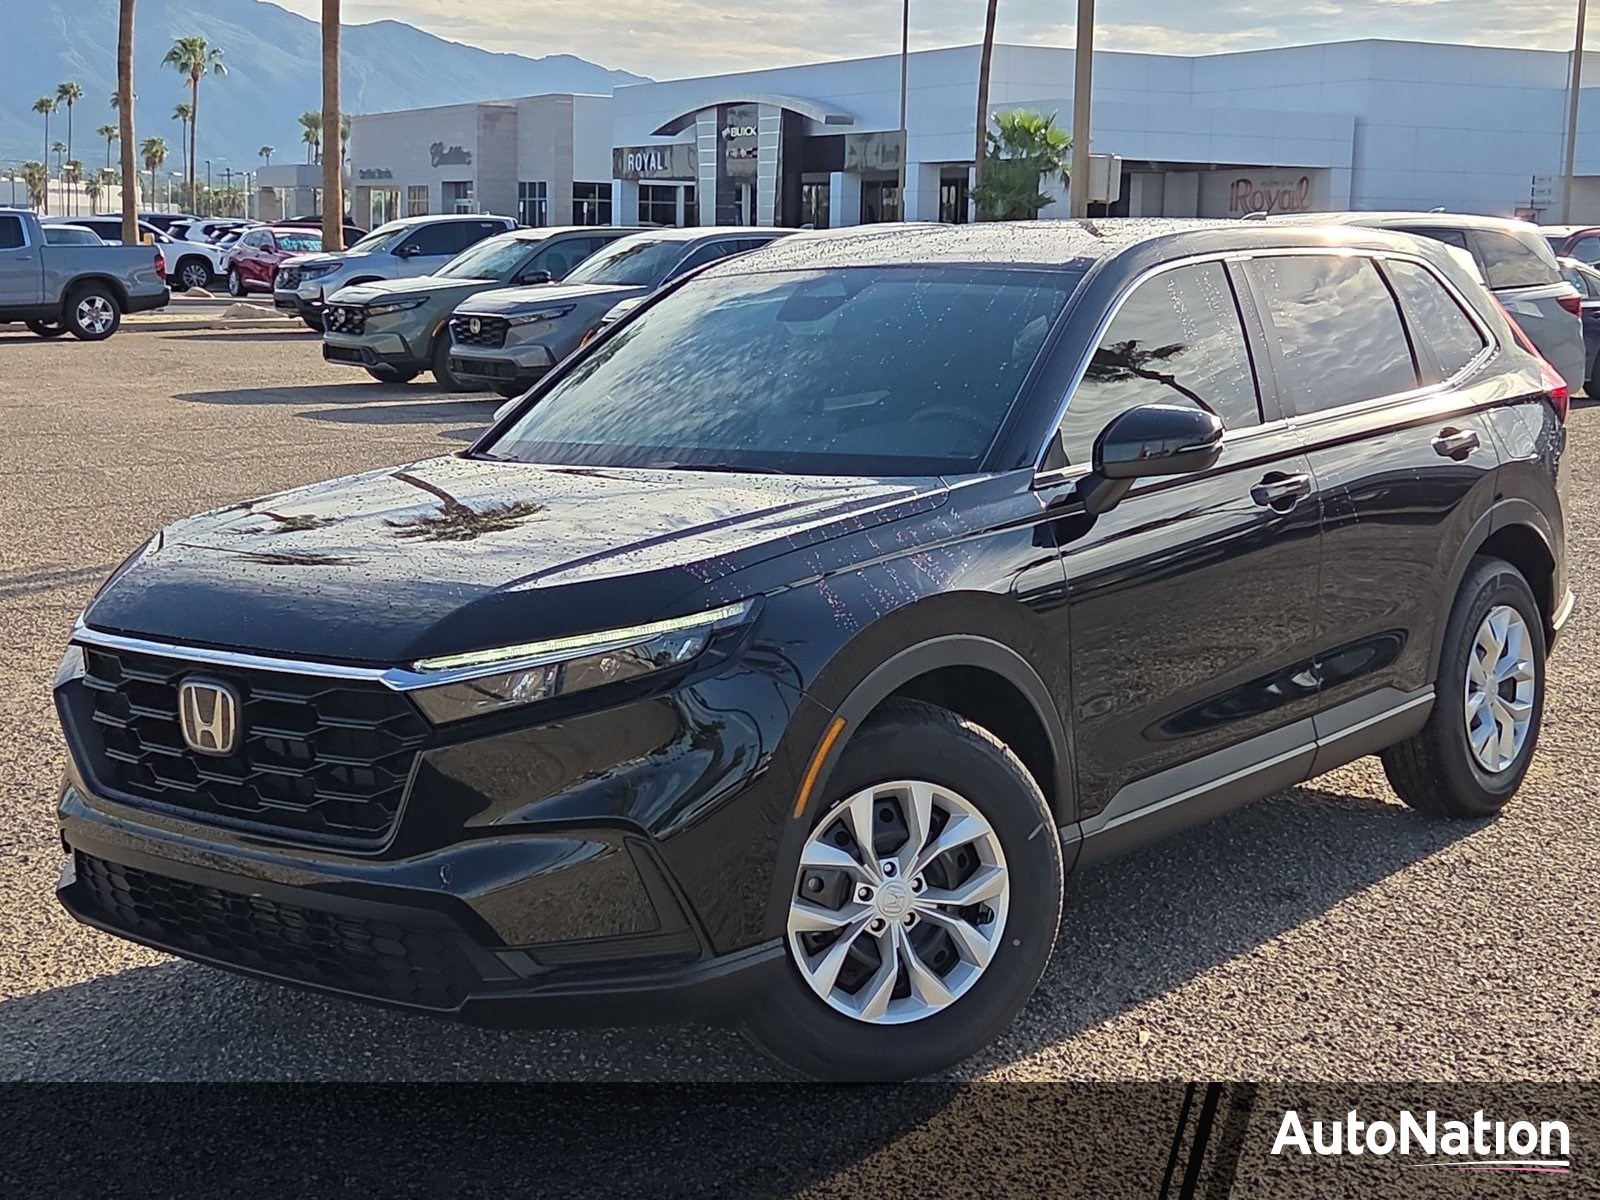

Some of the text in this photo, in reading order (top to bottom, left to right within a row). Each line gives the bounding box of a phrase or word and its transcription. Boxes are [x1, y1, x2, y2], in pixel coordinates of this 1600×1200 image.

[730, 126, 758, 138] BUICK
[627, 151, 664, 172] ROYAL
[1229, 176, 1311, 215] Royal
